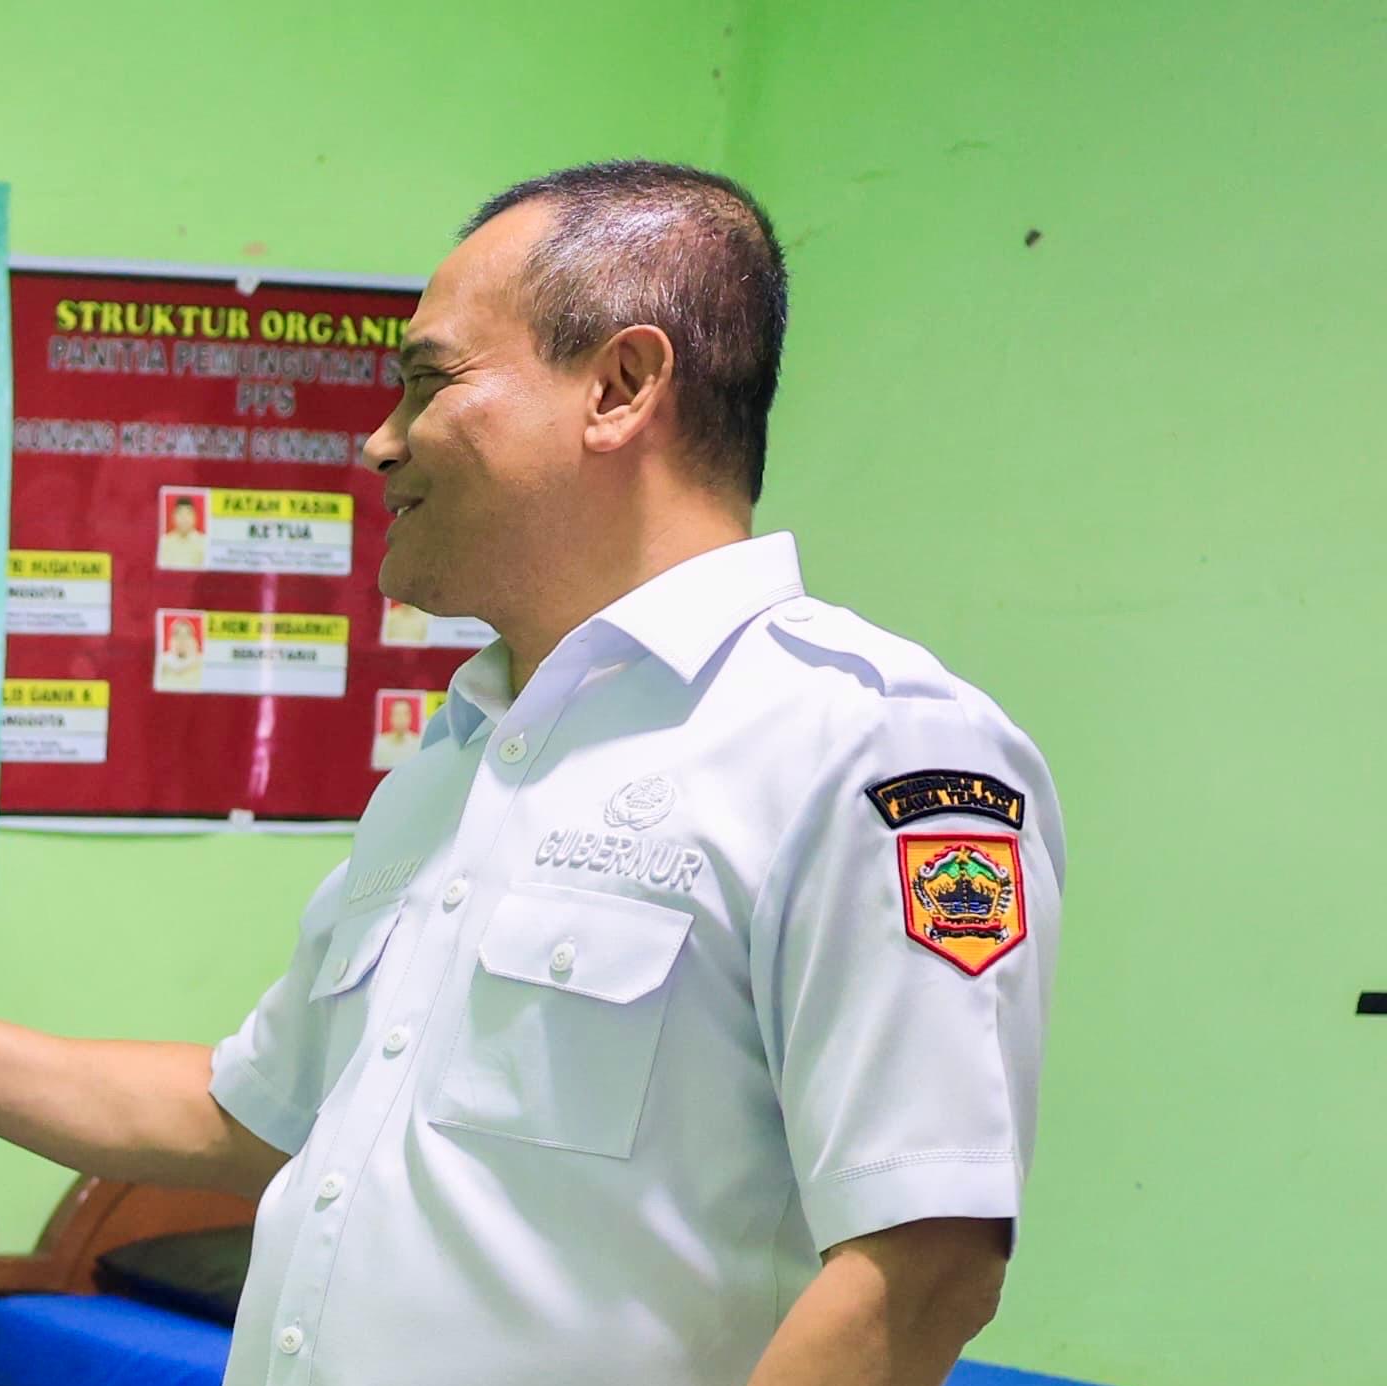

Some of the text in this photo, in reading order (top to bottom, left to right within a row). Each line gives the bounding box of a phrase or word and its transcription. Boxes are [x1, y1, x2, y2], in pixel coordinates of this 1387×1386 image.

[56, 300, 250, 339] STRUKTUR
[48, 335, 167, 374] PANITIA
[174, 340, 376, 384] PEMUNGUTAN
[236, 381, 296, 417] PPS
[247, 522, 312, 540] KETUA
[535, 829, 703, 892] GUBERNUR
